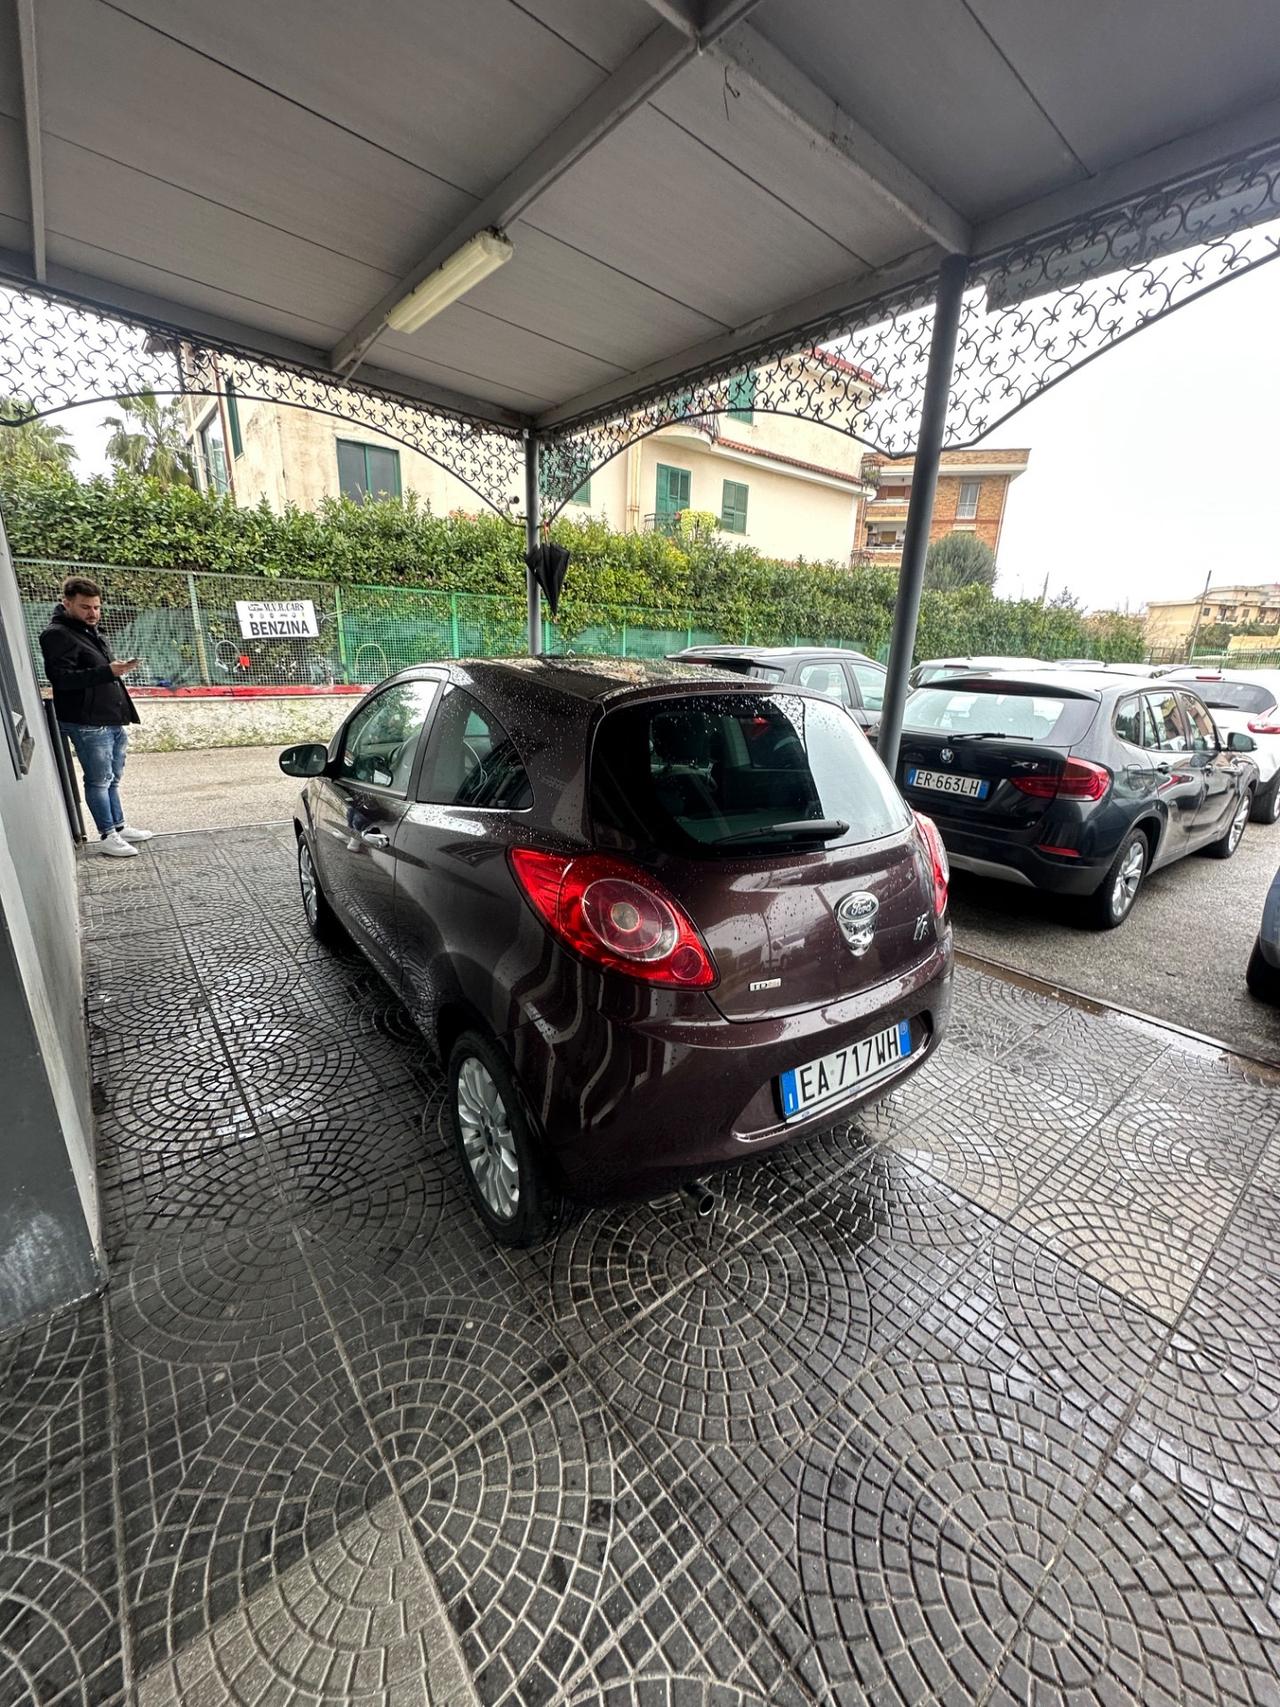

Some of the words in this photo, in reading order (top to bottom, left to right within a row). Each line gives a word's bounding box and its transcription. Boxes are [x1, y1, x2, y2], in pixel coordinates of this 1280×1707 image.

[250, 620, 310, 636] BENZINA
[850, 898, 873, 916] Ford
[799, 1060, 830, 1102] EA
[836, 1027, 899, 1086] 717WH
